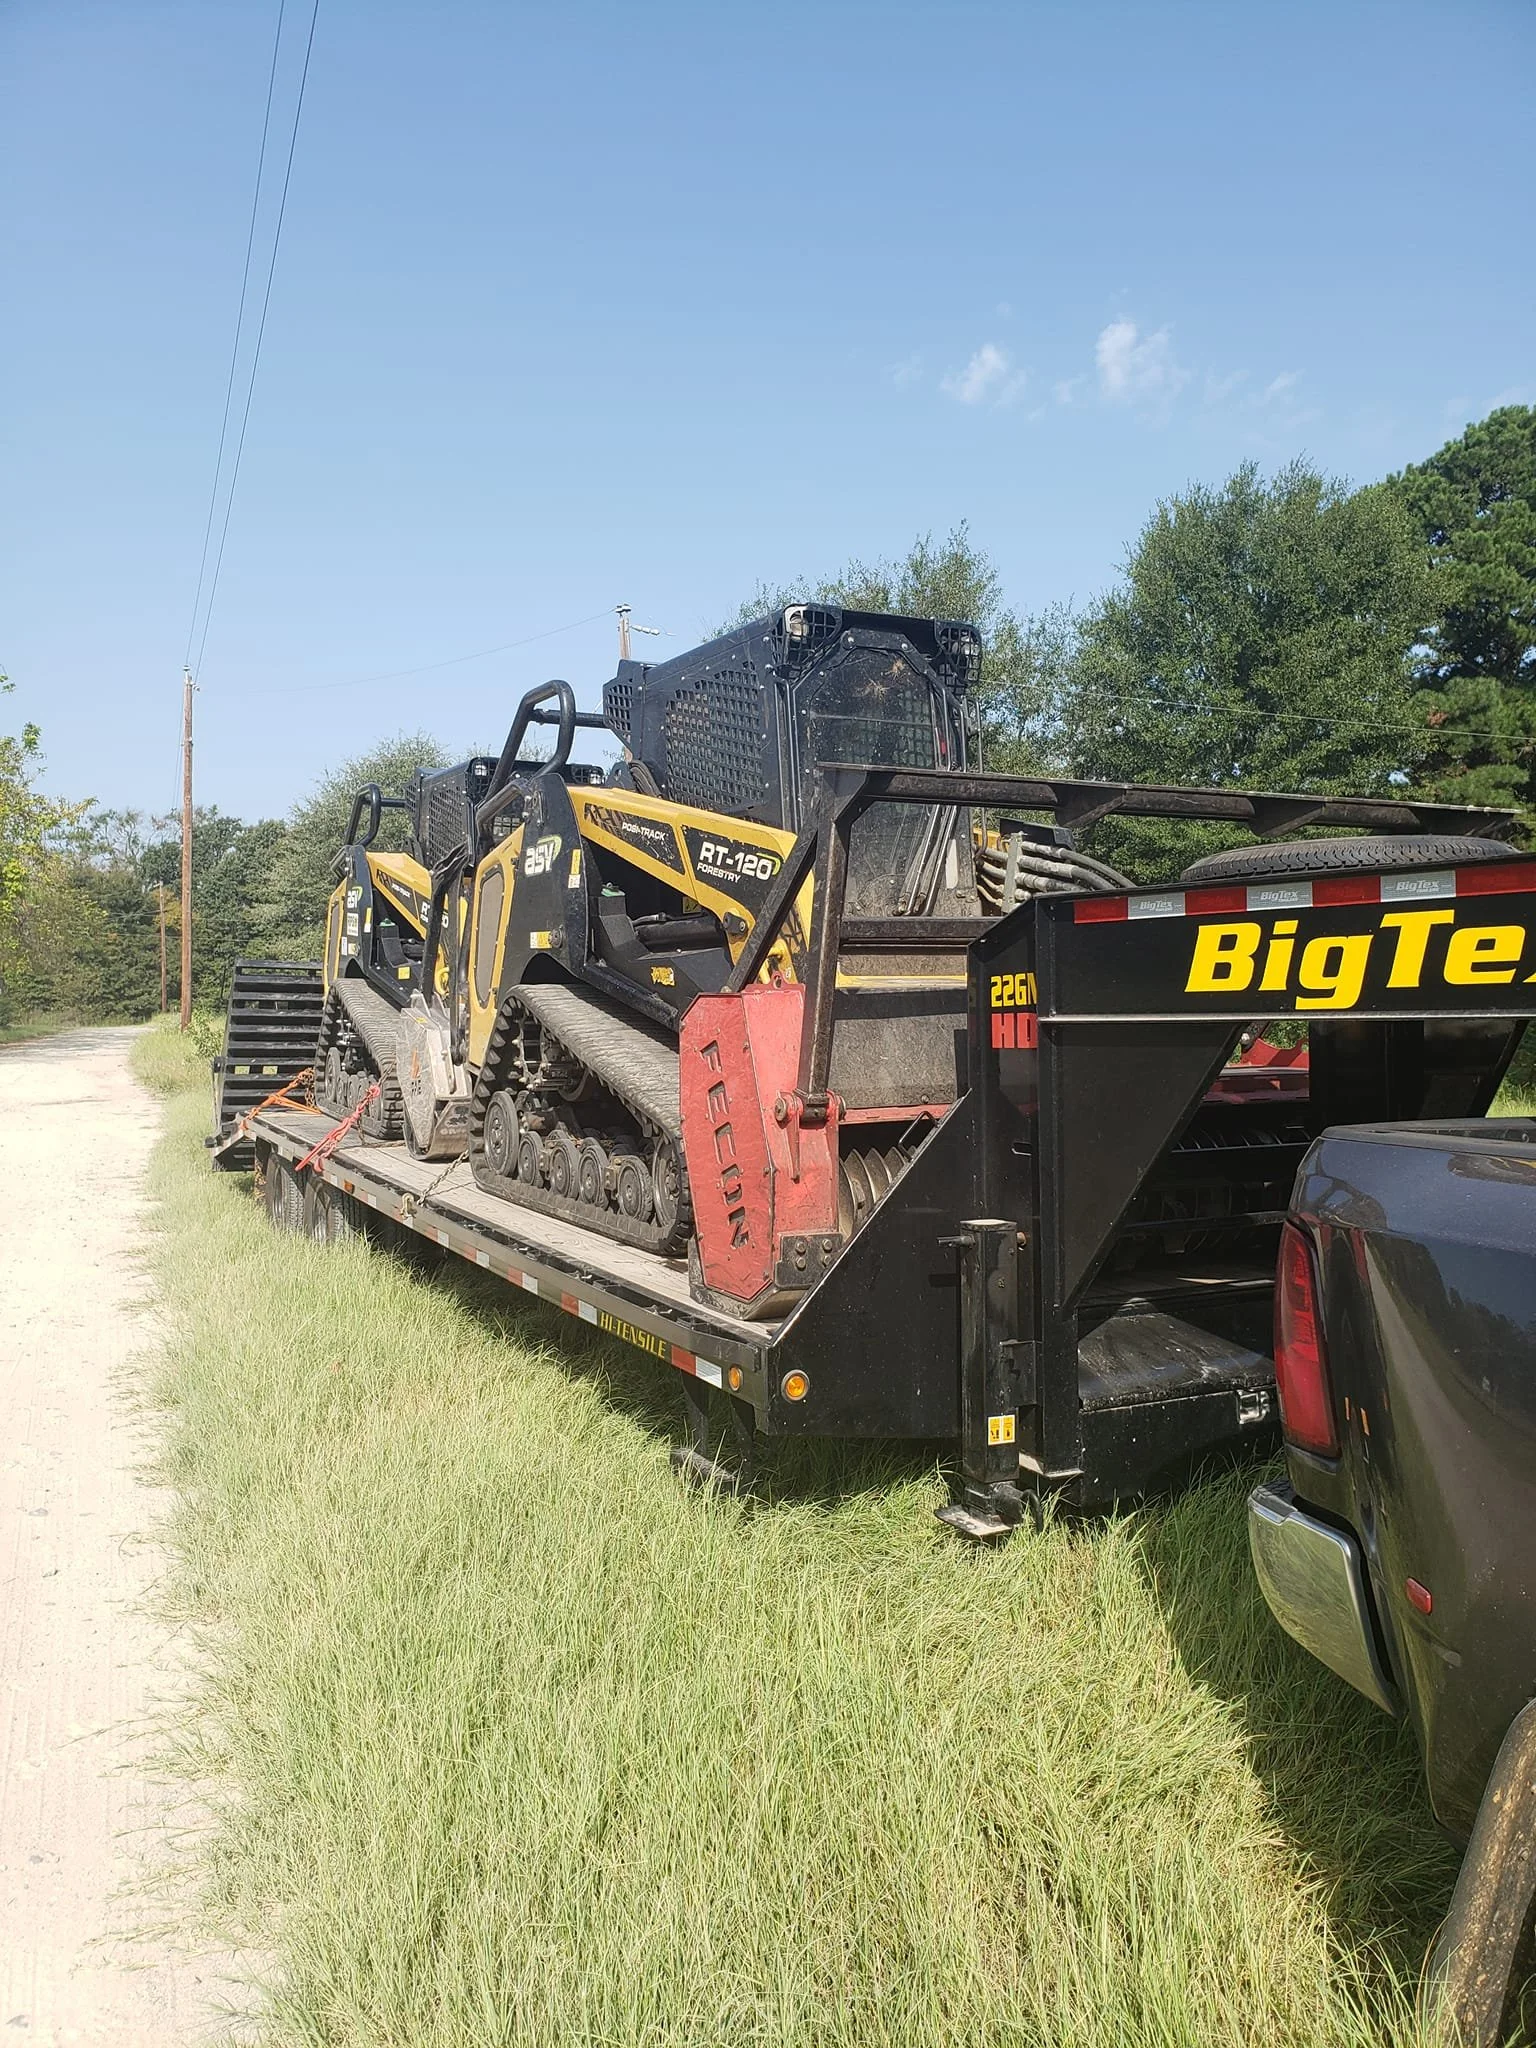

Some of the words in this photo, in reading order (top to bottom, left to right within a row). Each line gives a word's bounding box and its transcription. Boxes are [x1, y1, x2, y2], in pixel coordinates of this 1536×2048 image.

[621, 821, 666, 841] POSI-TRACK
[696, 861, 742, 884] FORESTRY
[699, 841, 773, 881] RT-120
[1184, 909, 1536, 1011] BigTe
[699, 1039, 751, 1250] FECON
[600, 1310, 667, 1360] HI-TENSILE
